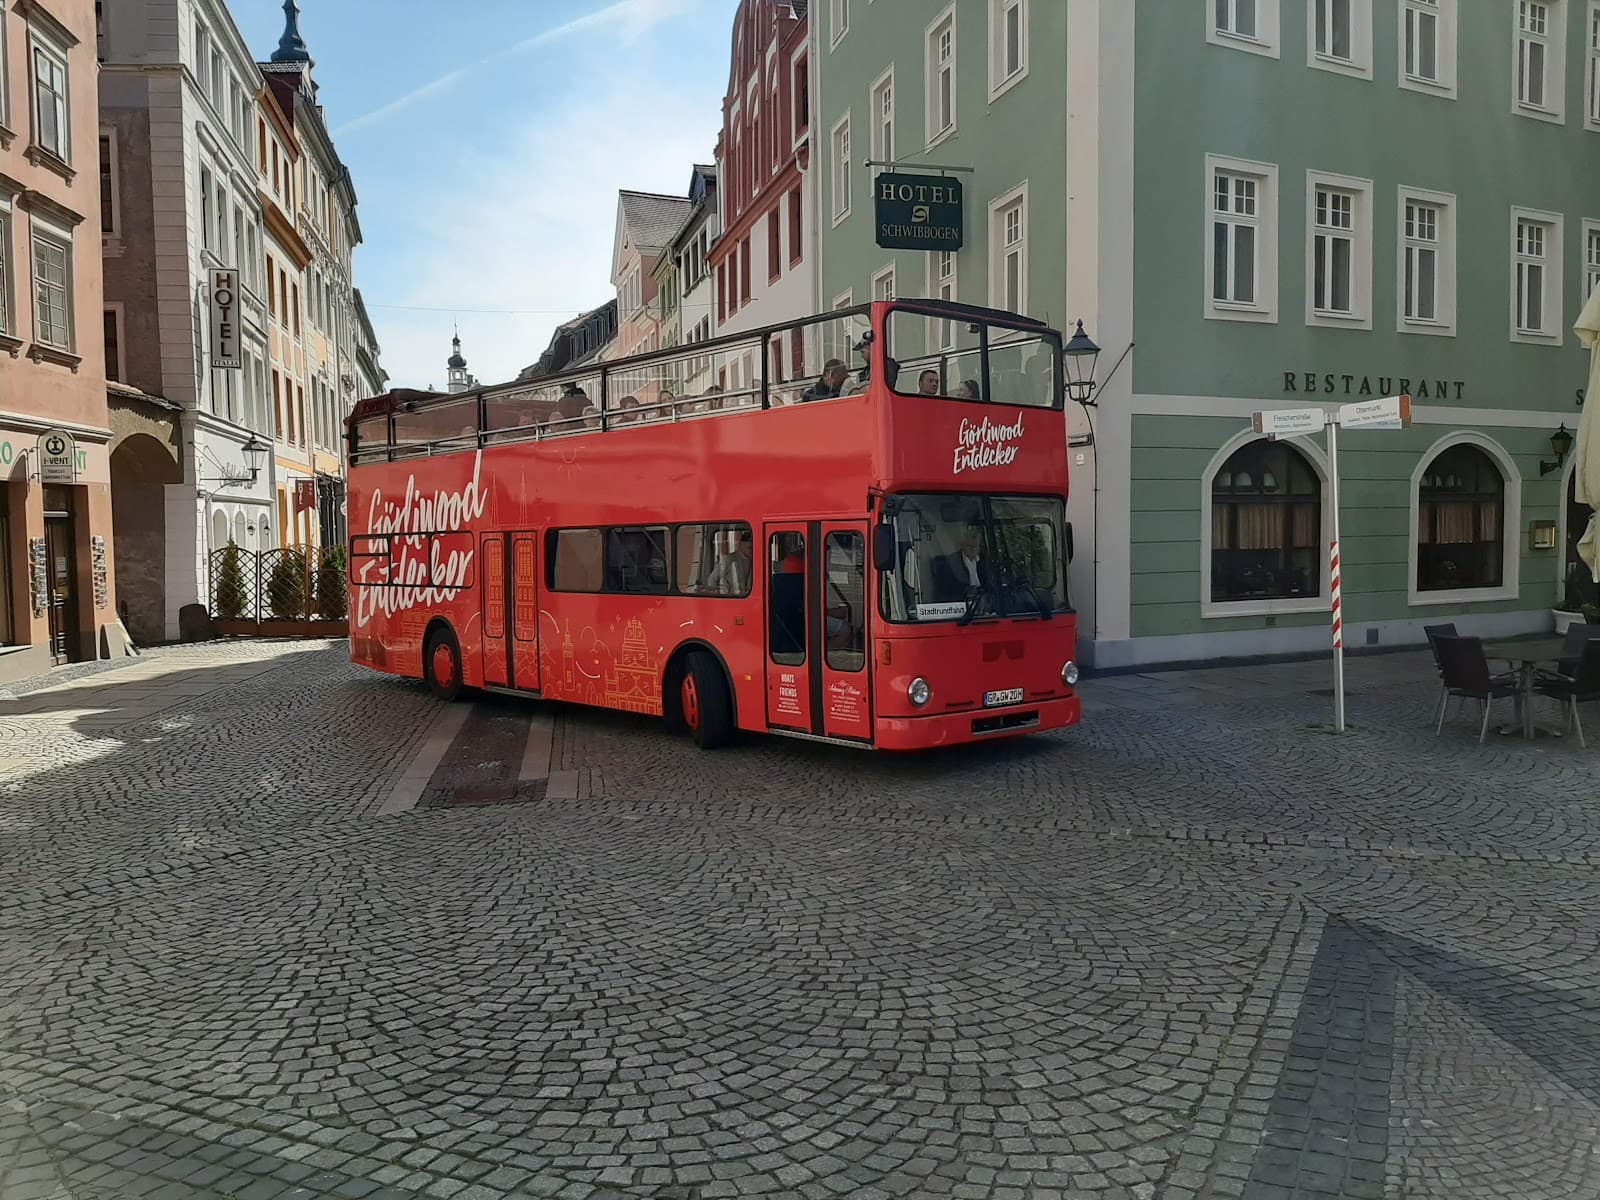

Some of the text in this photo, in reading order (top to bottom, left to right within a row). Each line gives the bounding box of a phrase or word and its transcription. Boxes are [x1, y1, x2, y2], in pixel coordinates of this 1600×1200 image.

[880, 183, 959, 205] HOTEL
[881, 223, 959, 240] SCHWIBBOGEN
[214, 272, 233, 357] HOTEL
[1283, 371, 1465, 400] RESTAURANT
[958, 410, 1025, 448] Görliwood
[953, 442, 1019, 474] Entdecker
[367, 448, 488, 562] Görliwood
[356, 538, 474, 629] Entdecker
